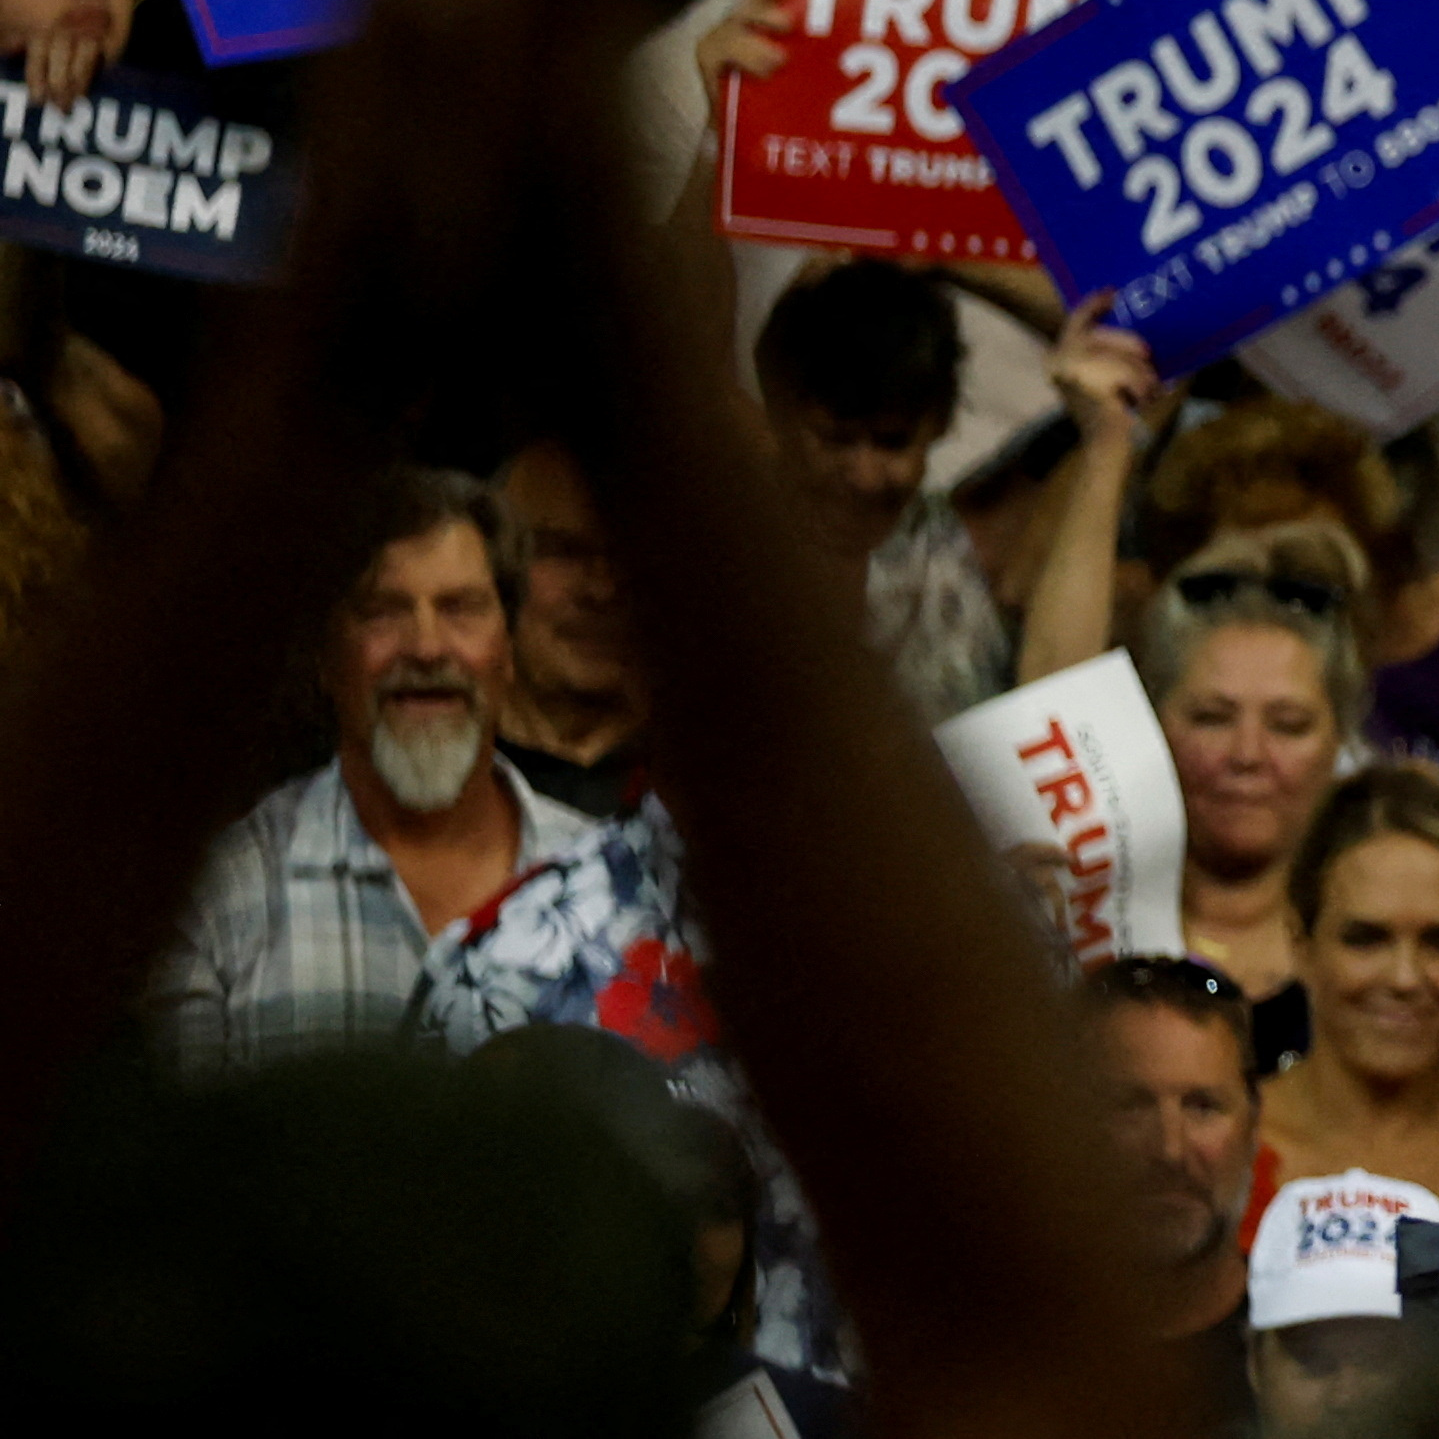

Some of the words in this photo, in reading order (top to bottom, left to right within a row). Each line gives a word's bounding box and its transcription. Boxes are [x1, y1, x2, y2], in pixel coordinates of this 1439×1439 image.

[0, 79, 273, 180] TRUMP
[831, 42, 971, 143] 20
[1122, 31, 1397, 254] 2024
[3, 139, 243, 242] NOEM
[763, 134, 854, 182] TEXT
[1114, 258, 1195, 327] TEXT
[1195, 181, 1319, 274] TRUMP
[1319, 147, 1378, 200] TO
[1298, 1191, 1411, 1215] TRUMP
